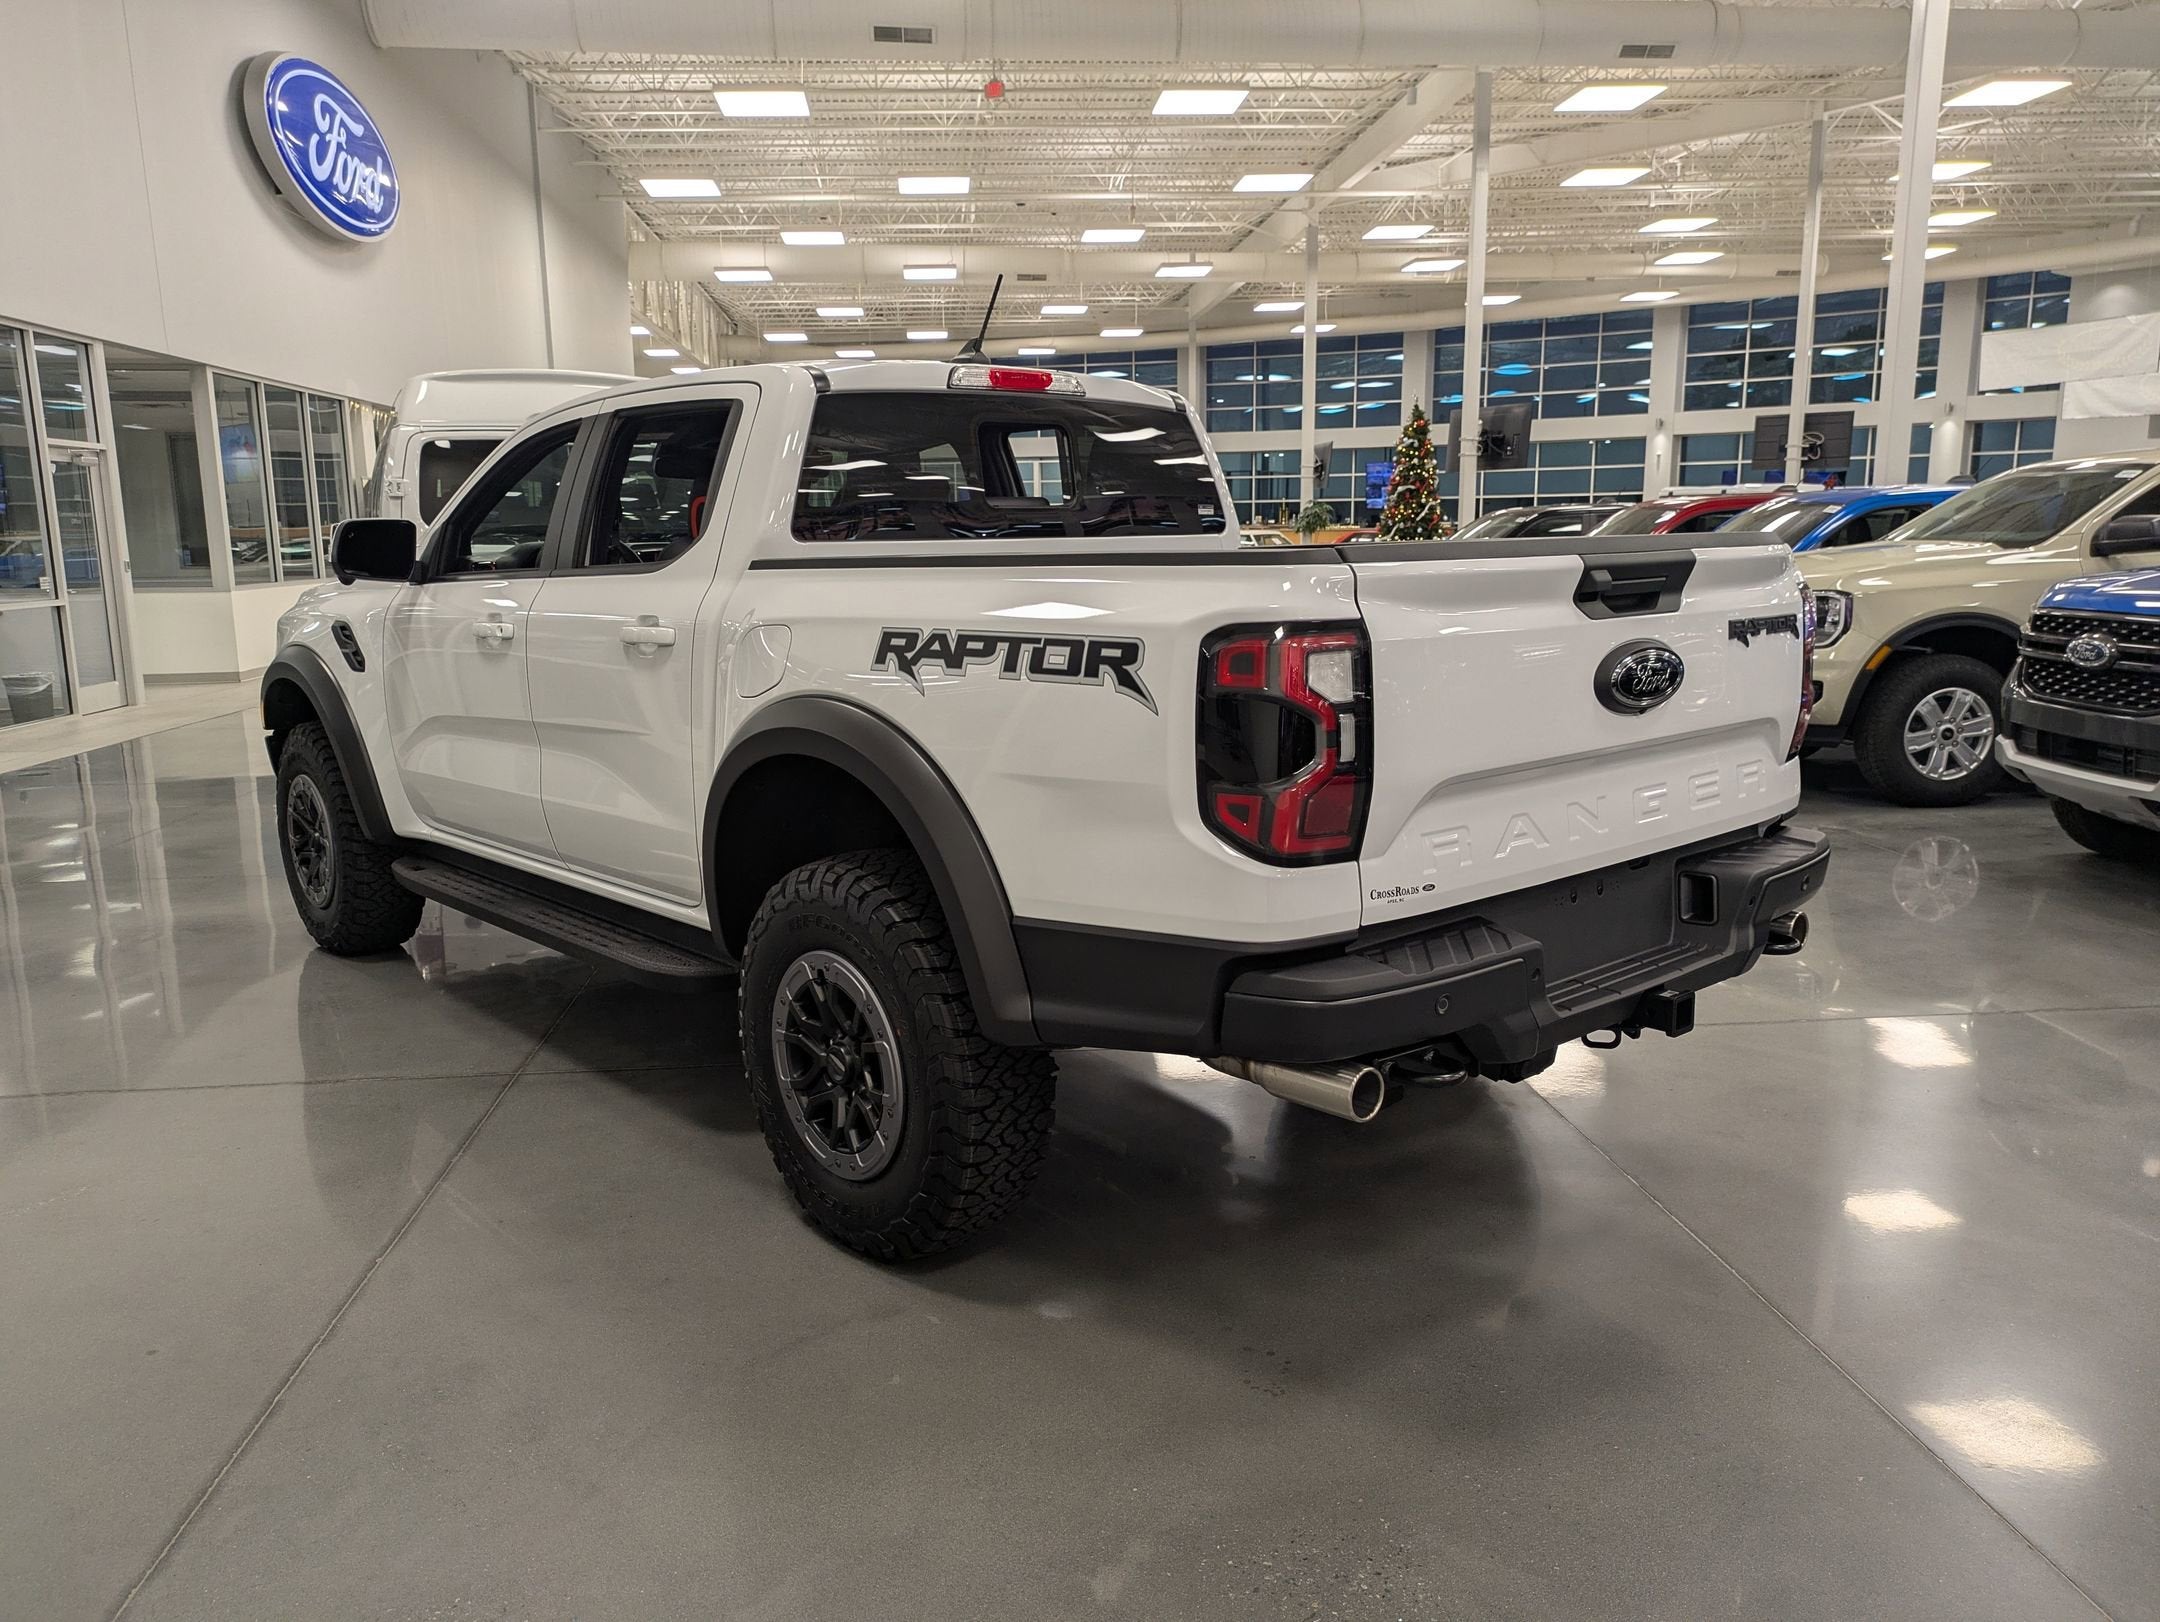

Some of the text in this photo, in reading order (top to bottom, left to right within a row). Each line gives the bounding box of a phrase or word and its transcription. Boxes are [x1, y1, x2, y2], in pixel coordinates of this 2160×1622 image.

[309, 93, 385, 213] Ford
[1728, 614, 1800, 648] RAPTOR
[2073, 643, 2099, 660] Ford
[871, 627, 1159, 716] RAPTOR
[1632, 661, 1672, 694] Ford
[1420, 758, 1767, 875] RANGER
